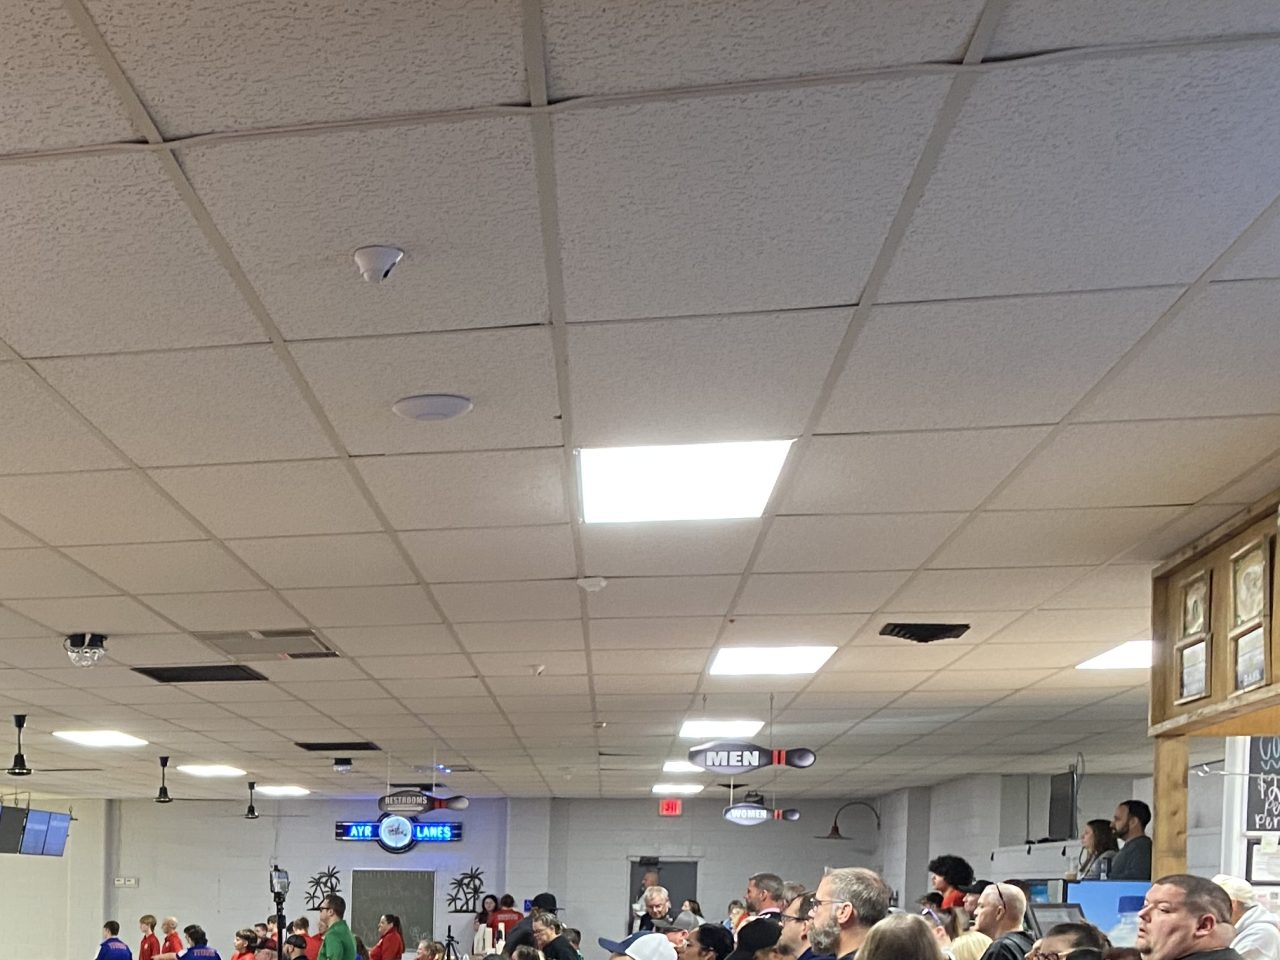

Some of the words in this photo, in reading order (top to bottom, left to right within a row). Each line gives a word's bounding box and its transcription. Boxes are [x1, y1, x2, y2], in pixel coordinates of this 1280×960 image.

[706, 750, 760, 766] MEN
[385, 796, 428, 805] RESTROOMS
[731, 809, 767, 818] WOMEN
[350, 825, 372, 837] AYR
[416, 826, 451, 838] LANES
